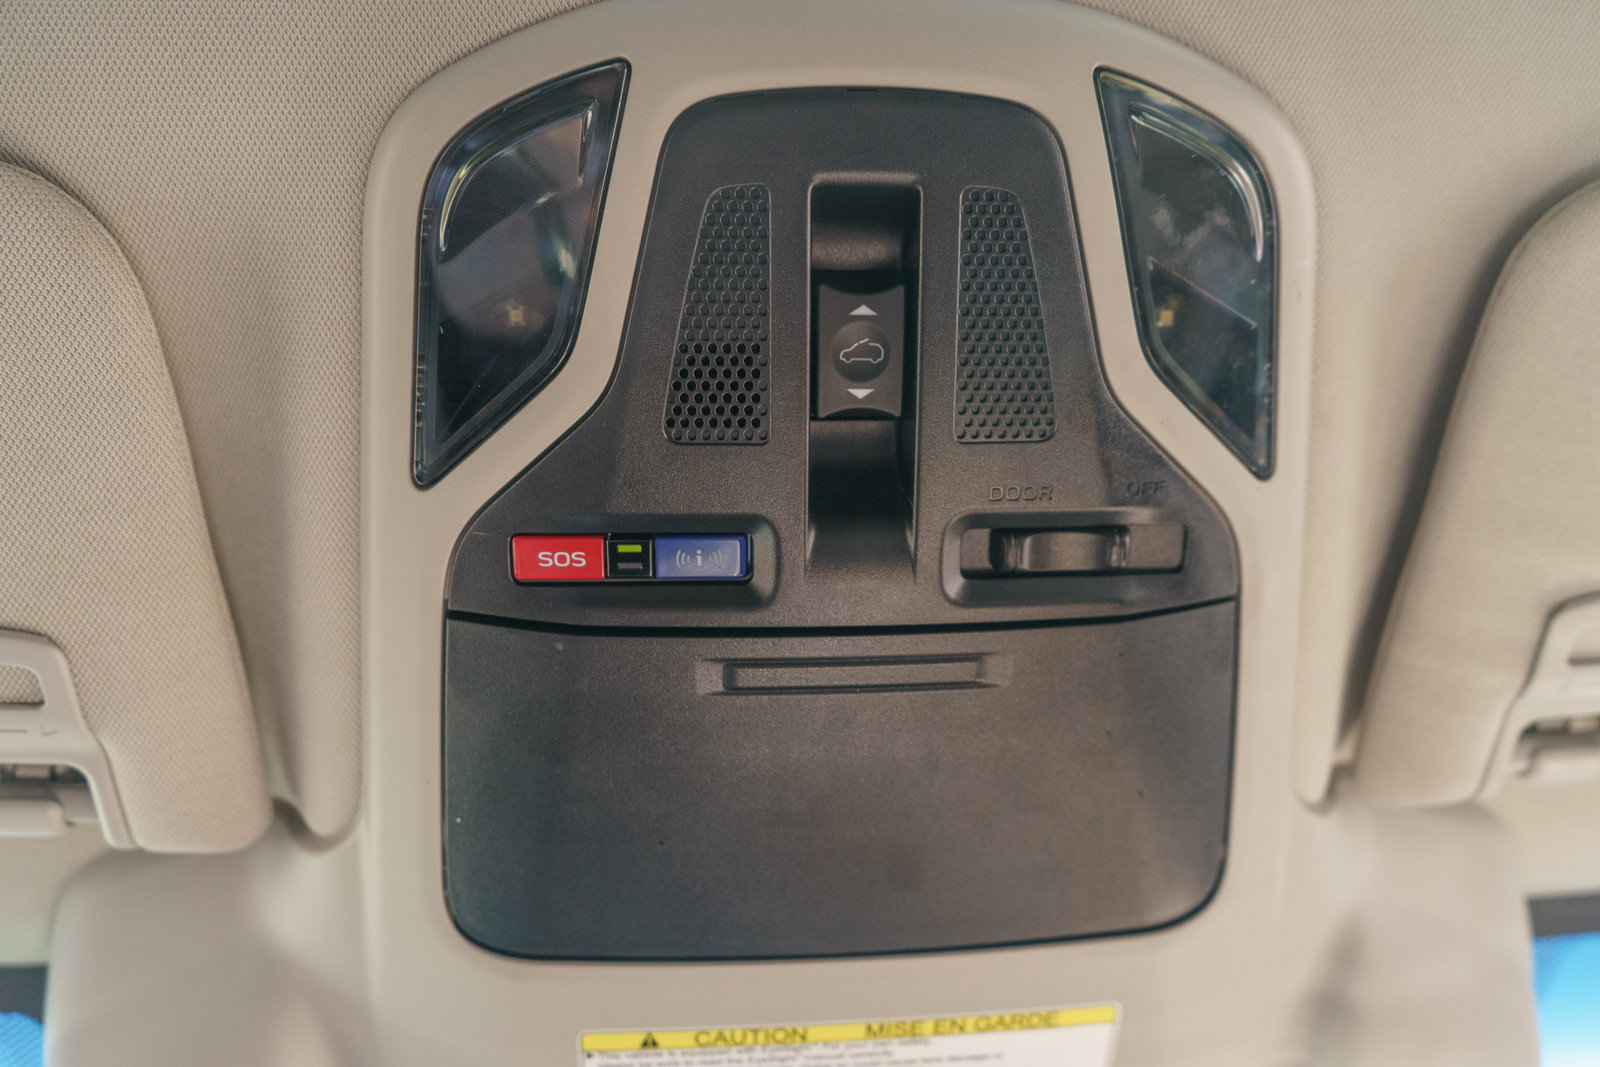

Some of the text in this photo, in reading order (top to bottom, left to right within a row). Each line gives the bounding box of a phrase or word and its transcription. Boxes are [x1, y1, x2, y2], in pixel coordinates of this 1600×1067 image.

[989, 485, 1055, 501] DOOR
[1126, 480, 1166, 498] OFF
[538, 551, 587, 567] SOS
[864, 1010, 1059, 1039] MISE EN GARDE
[694, 1026, 808, 1047] CAUTION
